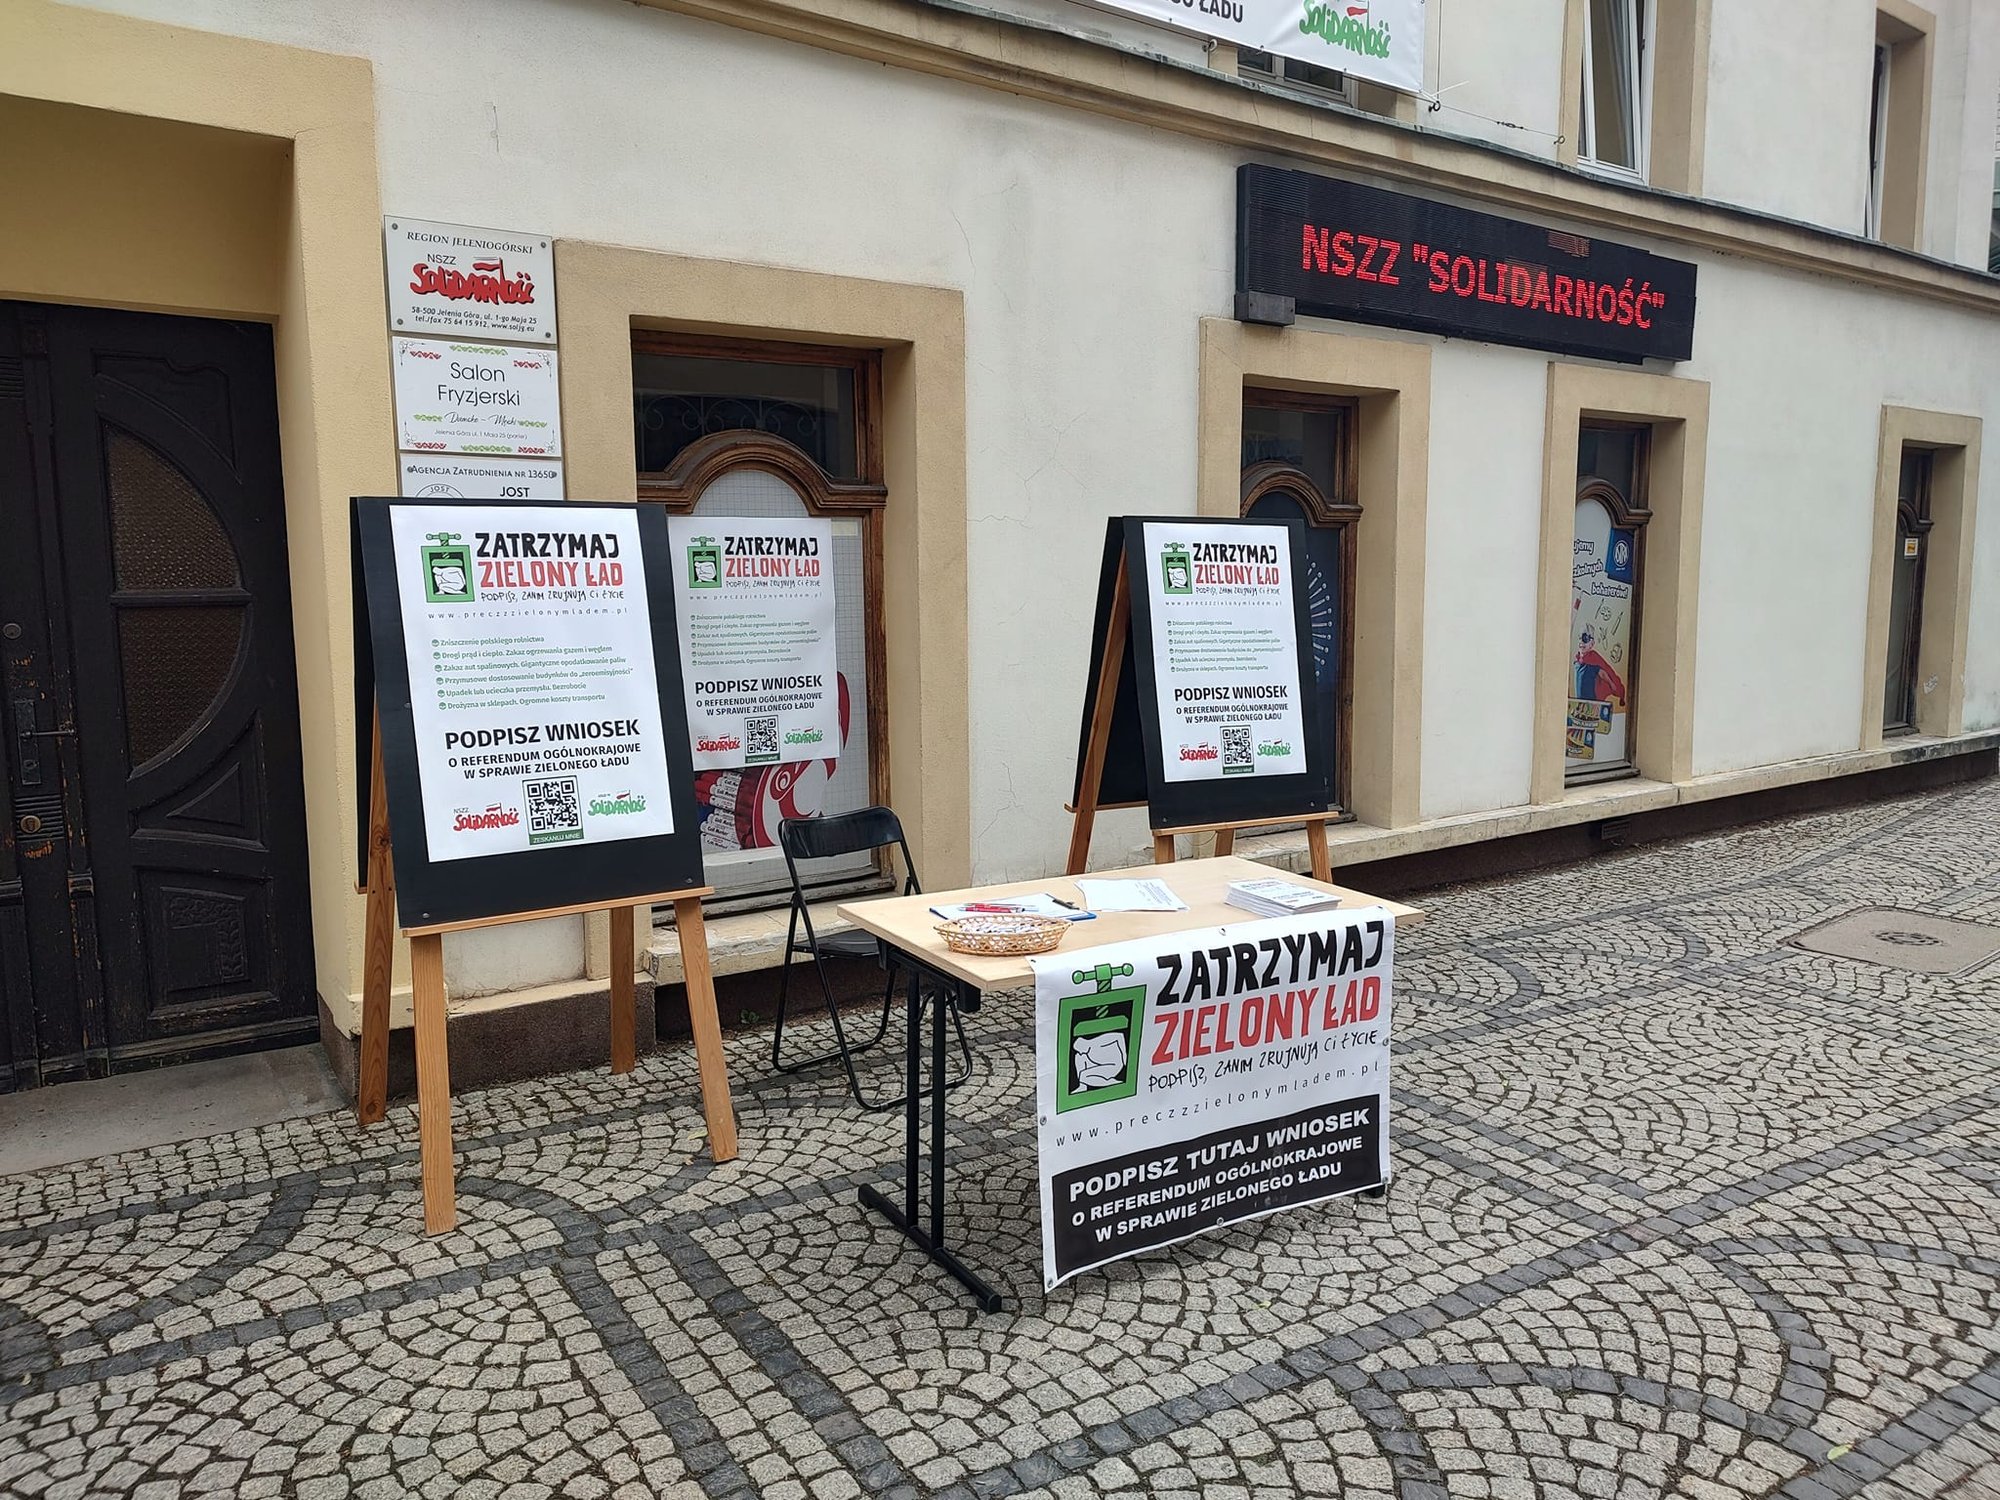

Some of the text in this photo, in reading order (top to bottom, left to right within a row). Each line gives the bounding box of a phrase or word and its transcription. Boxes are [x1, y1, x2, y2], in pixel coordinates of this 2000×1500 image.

[1199, 0, 1243, 23] ŁADU
[407, 231, 533, 254] REGION JELENIOGÓRSKI
[427, 253, 457, 265] NSZZ
[1302, 224, 1665, 329] NSZZ "SOLIDARNOŚĆ"
[412, 306, 436, 315] 58-500
[437, 309, 462, 318] Jelenia
[464, 311, 483, 320] Góra,
[511, 316, 527, 324] Maja
[529, 317, 537, 325] 25
[444, 317, 452, 325] 75
[454, 318, 462, 326] 64
[465, 319, 473, 327] 15
[450, 361, 505, 382] Salon
[438, 384, 521, 407] Fryzjerski
[430, 485, 449, 493] JOST
[500, 486, 530, 498] JOST
[475, 532, 619, 559] ZATRZYMAJ
[724, 536, 818, 556] ZATRZYMAJ
[1193, 543, 1276, 565] ZATRZYMAJ
[477, 561, 623, 588] ZIELONY ŁAD
[725, 558, 820, 578] ZIELONY ŁAD
[1194, 564, 1279, 585] ZIELONY ŁAD
[522, 591, 544, 601] ZANIM
[480, 638, 513, 646] polskiego
[446, 689, 473, 697] Upadek
[695, 675, 822, 694] PODPISZ WNIOSEK
[1174, 685, 1288, 701] PODPISZ WNIOSEK
[705, 697, 757, 707] REFERENDUM
[759, 692, 822, 704] OGÓLNOKRAJOWE
[716, 706, 750, 715] SPRAWIE
[752, 703, 793, 713] ZIELONEGO
[1183, 705, 1230, 714] REFERENDUM
[1231, 703, 1288, 712] OGÓLNOKRAJOWE
[1185, 716, 1192, 724] W
[1194, 715, 1225, 723] SPRAWIE
[1226, 713, 1263, 722] ZIELONEGO
[445, 719, 640, 750] PODPISZ WNIOSEK
[448, 743, 641, 768] O REFERENDUM OGÓLNOKRAJOWE
[464, 756, 629, 779] W SPRAWIE ZIELONEGO ŁADU
[1156, 921, 1384, 1006] ZATRZYMAJ
[1151, 976, 1381, 1065] ZIELONY ŁAD
[1149, 1064, 1208, 1092] PODPISZ,
[1214, 1058, 1253, 1078] ZANIM
[1259, 1041, 1318, 1069] ZRUJNUJĄ
[1342, 1030, 1378, 1049] ŻYCIE
[1069, 1108, 1369, 1203] PODPISZ TUTAJ WNIOSEK
[1072, 1136, 1362, 1226] O REFERENDUM OGÓLNOKRAJOWE
[1095, 1162, 1342, 1242] W SPRAWIE ZIELONEGO ŁADU
